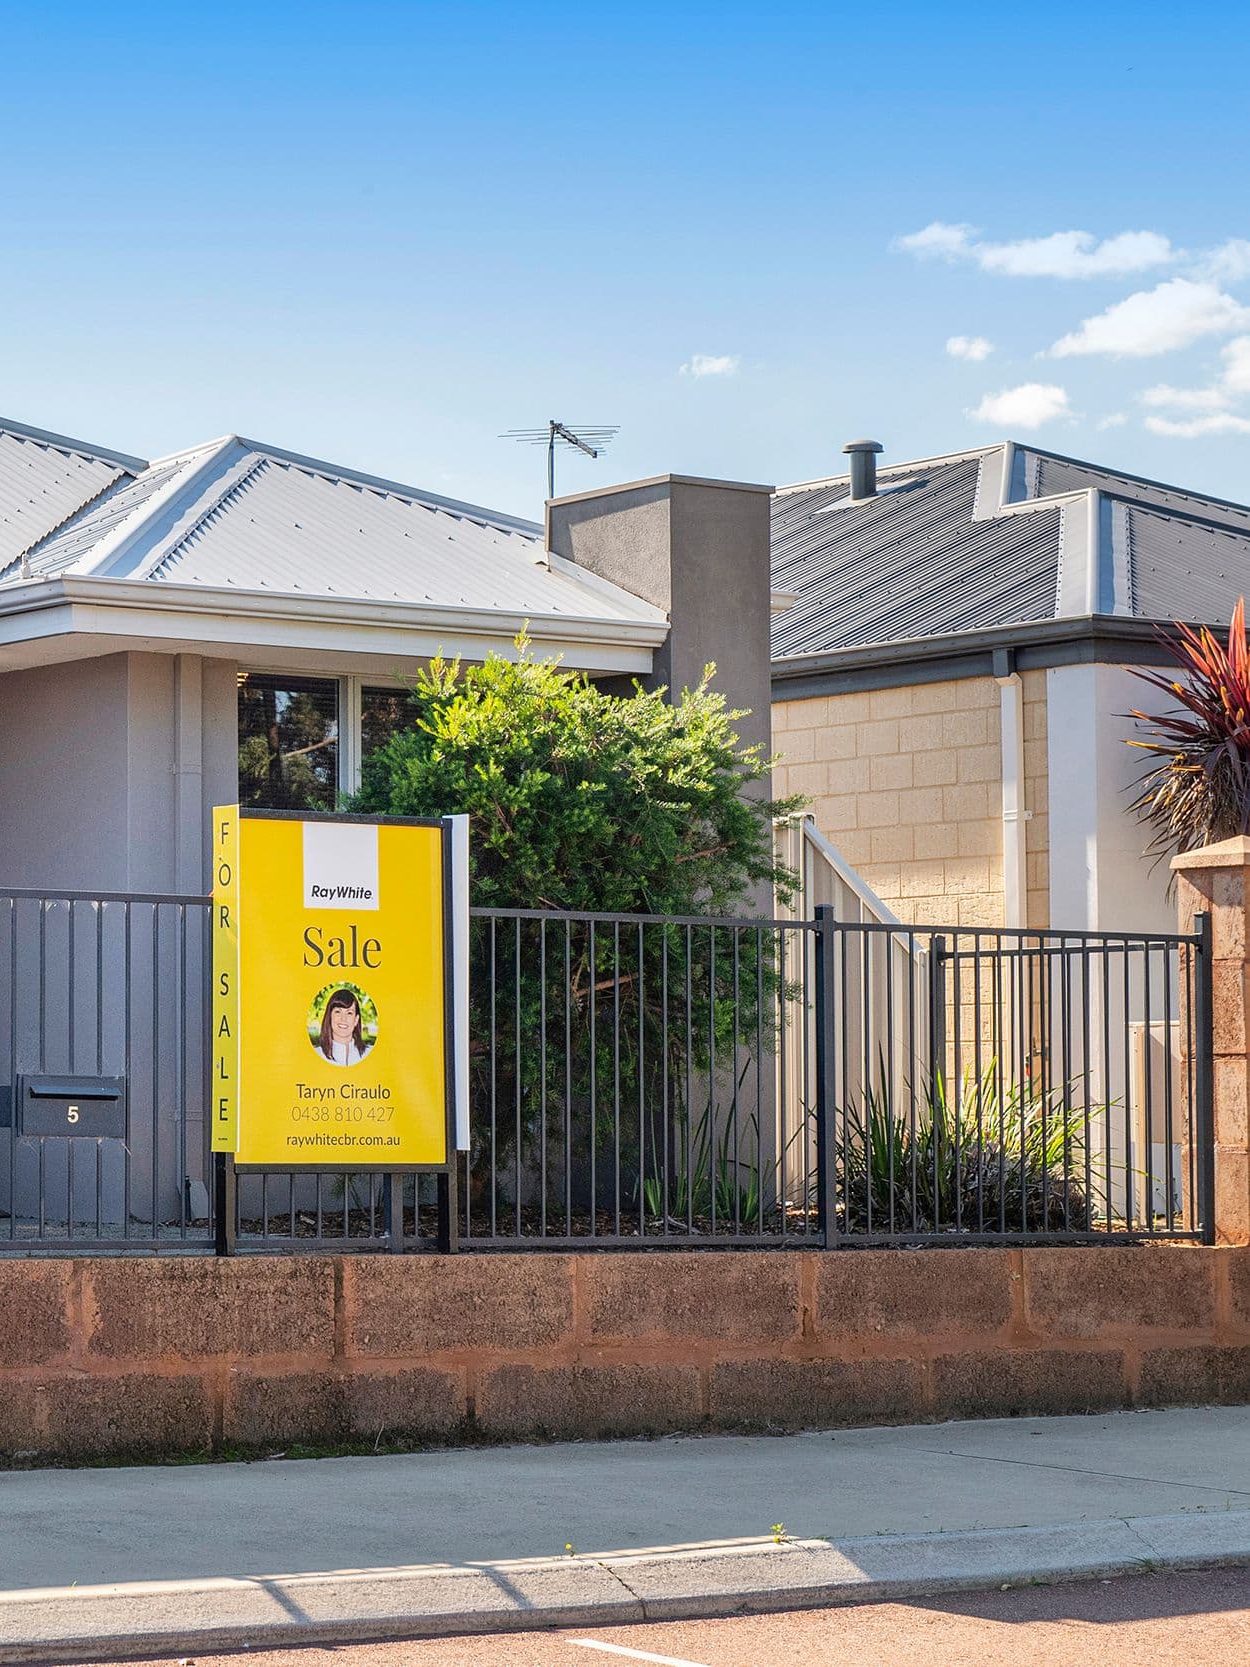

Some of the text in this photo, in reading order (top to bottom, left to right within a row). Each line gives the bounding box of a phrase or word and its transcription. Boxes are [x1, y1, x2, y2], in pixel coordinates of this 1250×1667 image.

[218, 822, 232, 929] FOR
[303, 925, 382, 969] Sale
[217, 972, 232, 1121] SALE
[295, 1083, 391, 1101] Taryn Ciraulo
[66, 1105, 80, 1124] 5
[291, 1106, 395, 1122] 0438 810 427
[286, 1133, 401, 1148] raywhitecbr.com.au
